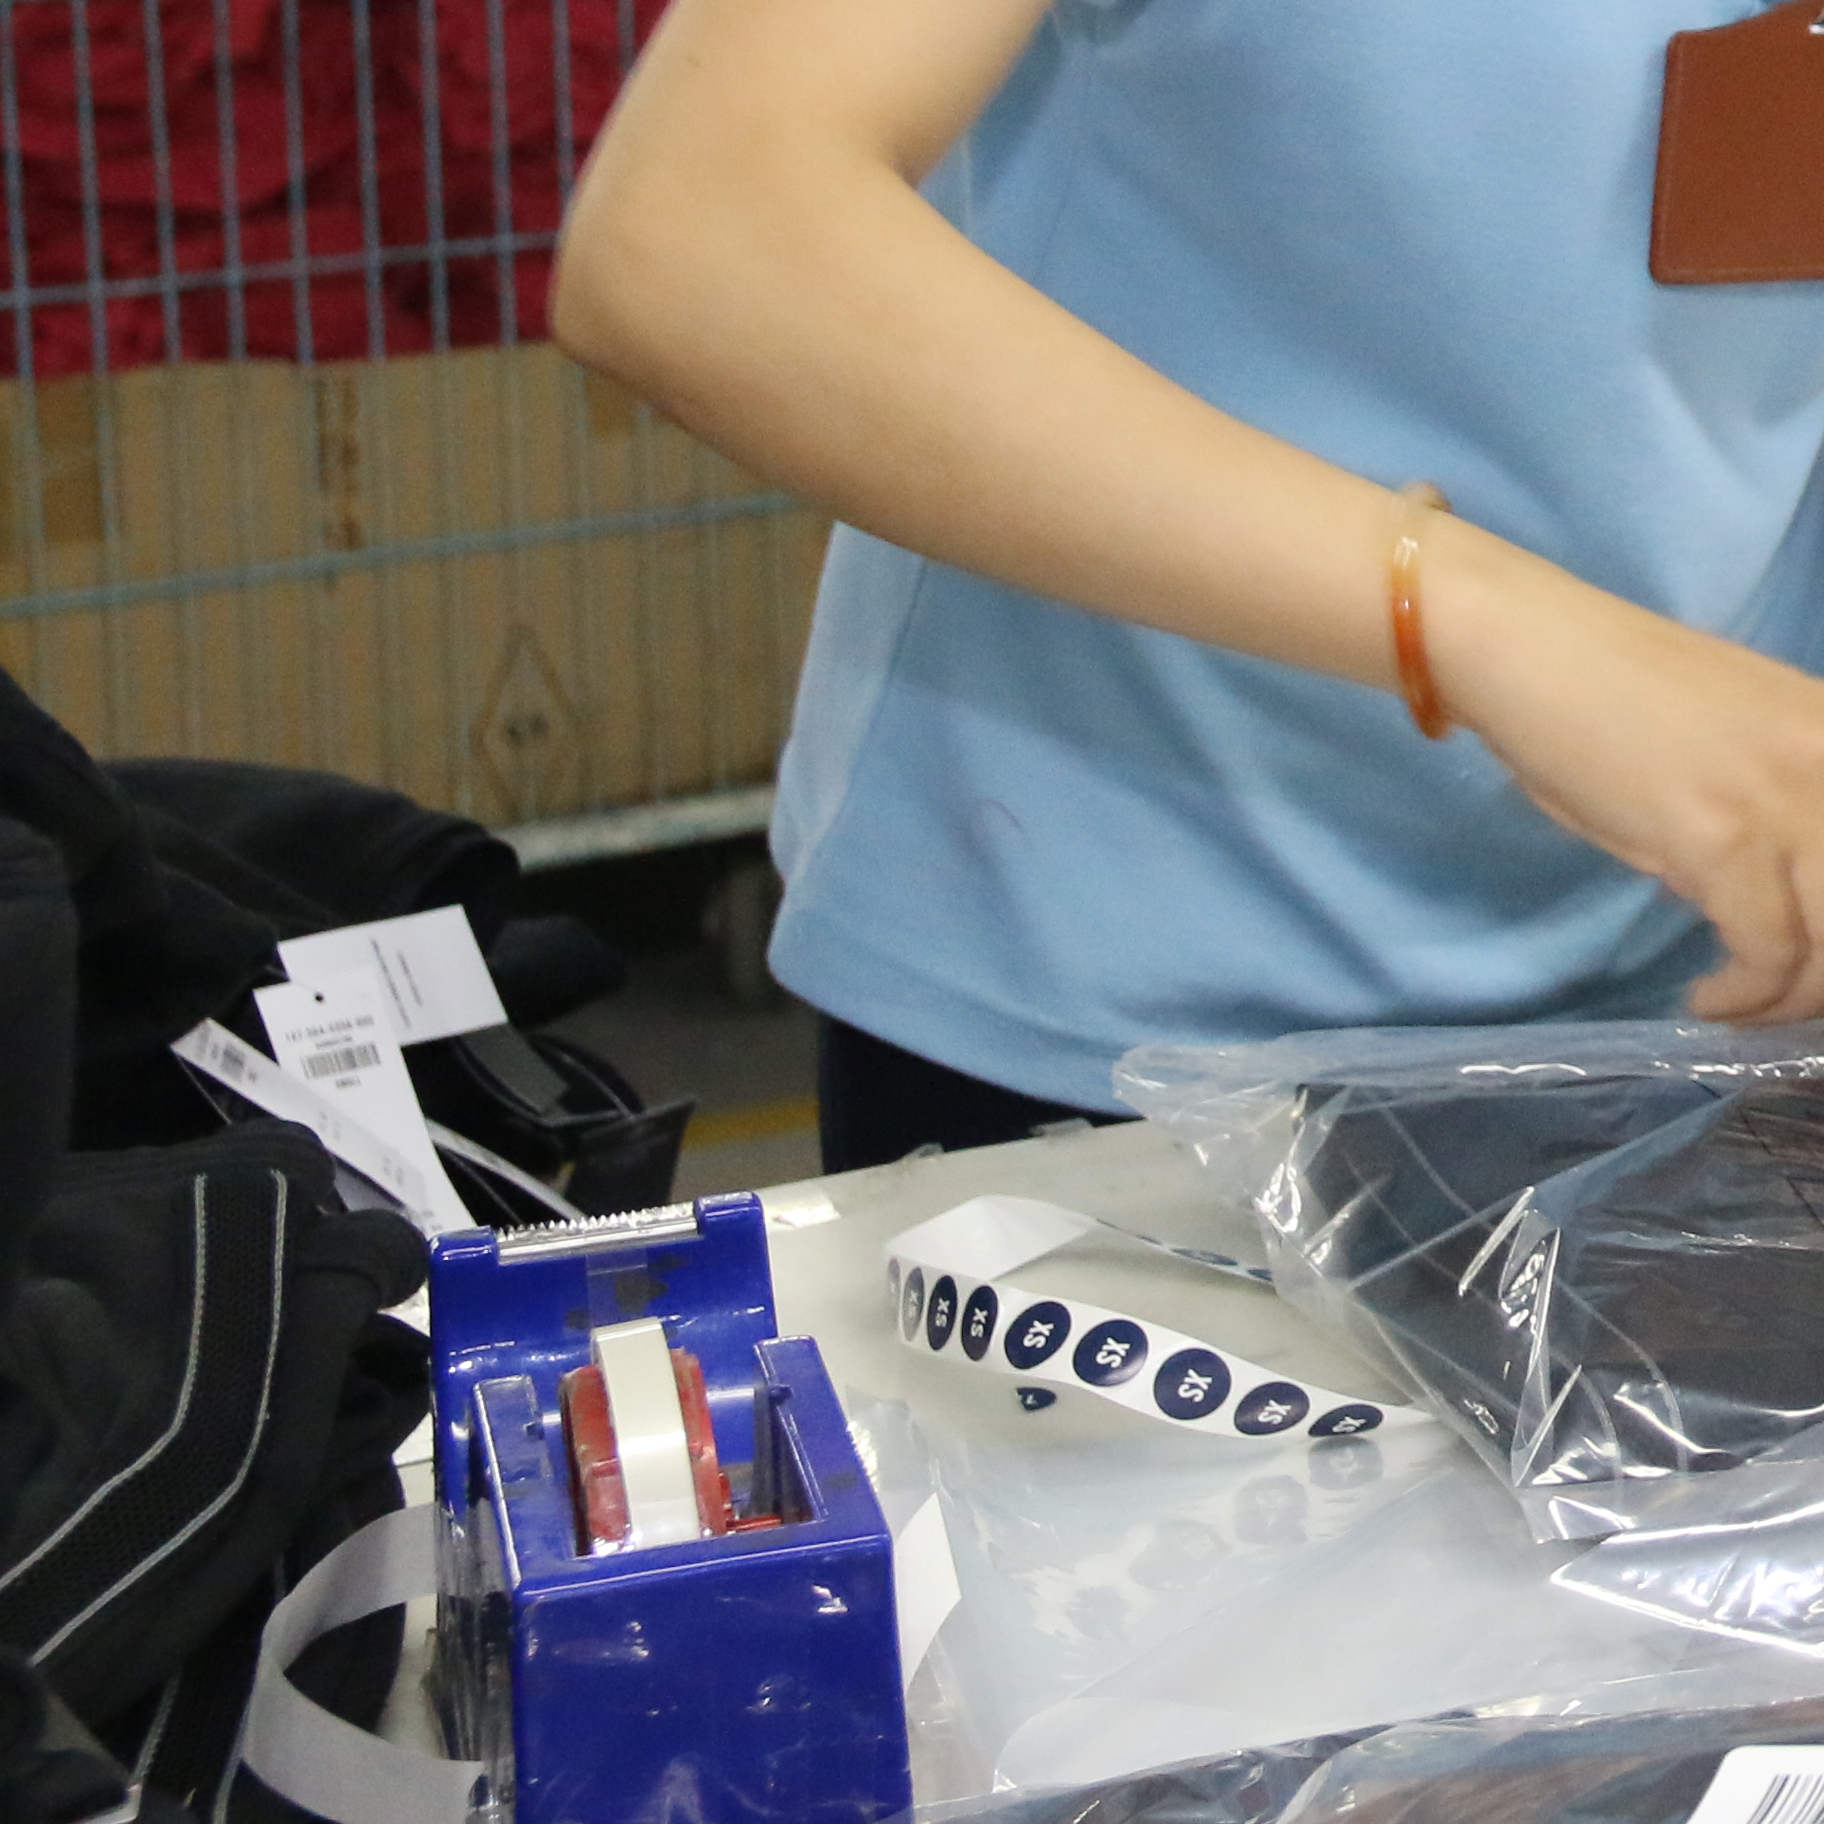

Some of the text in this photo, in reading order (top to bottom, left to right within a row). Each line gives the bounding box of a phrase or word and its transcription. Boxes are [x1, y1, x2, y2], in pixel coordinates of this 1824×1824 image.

[934, 1296, 951, 1328] XS
[970, 1307, 989, 1339] XS
[1022, 1320, 1056, 1349] XS
[1095, 1337, 1131, 1369] XS
[1177, 1368, 1213, 1403] XS
[1258, 1399, 1293, 1425] XS
